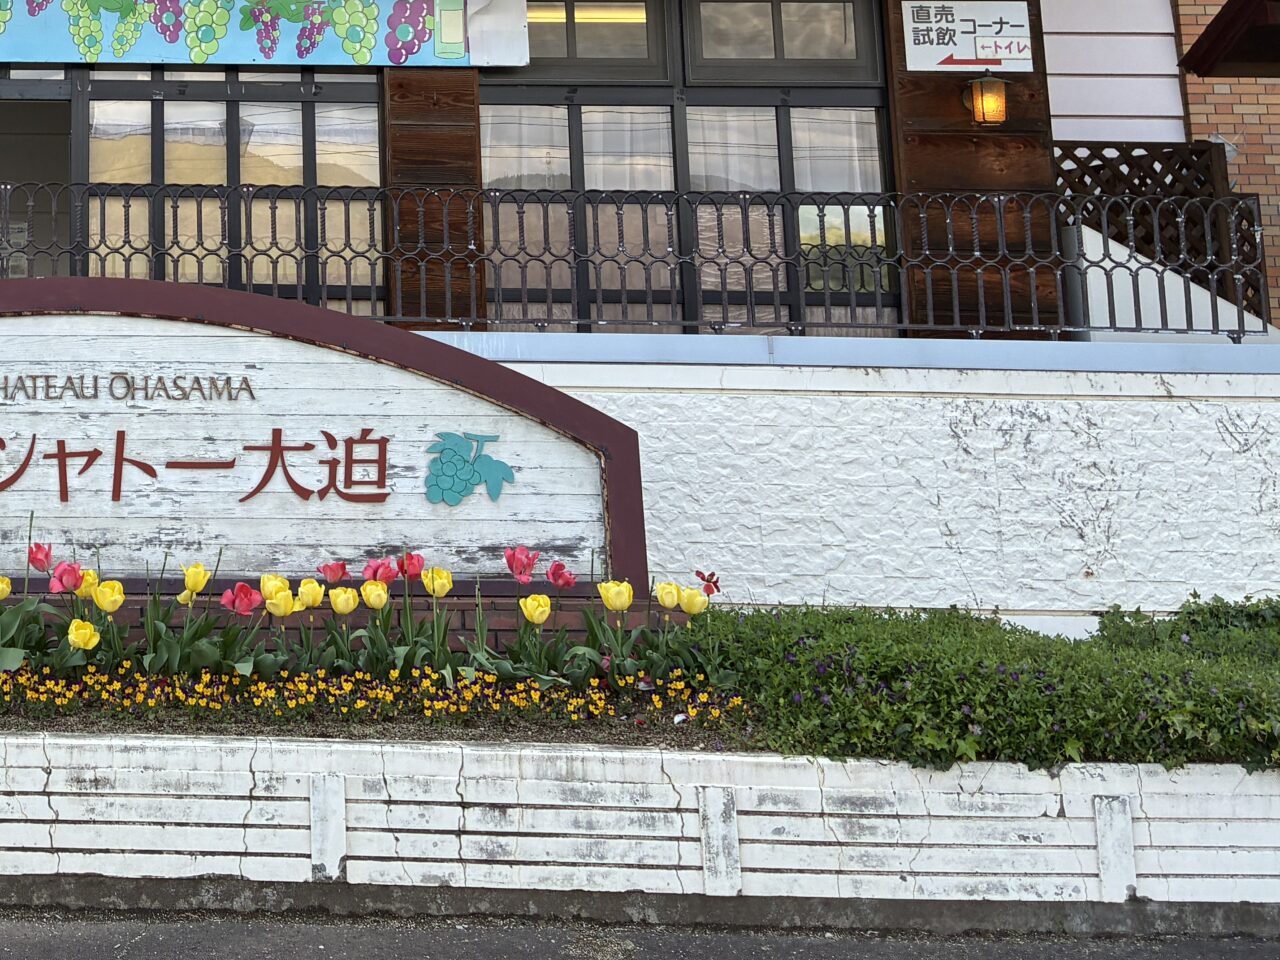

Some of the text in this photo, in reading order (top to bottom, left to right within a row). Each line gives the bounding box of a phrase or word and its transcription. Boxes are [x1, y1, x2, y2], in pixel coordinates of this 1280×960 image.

[911, 4, 955, 24] 直売
[959, 16, 1025, 35] コーナー
[912, 26, 957, 46] 試飲
